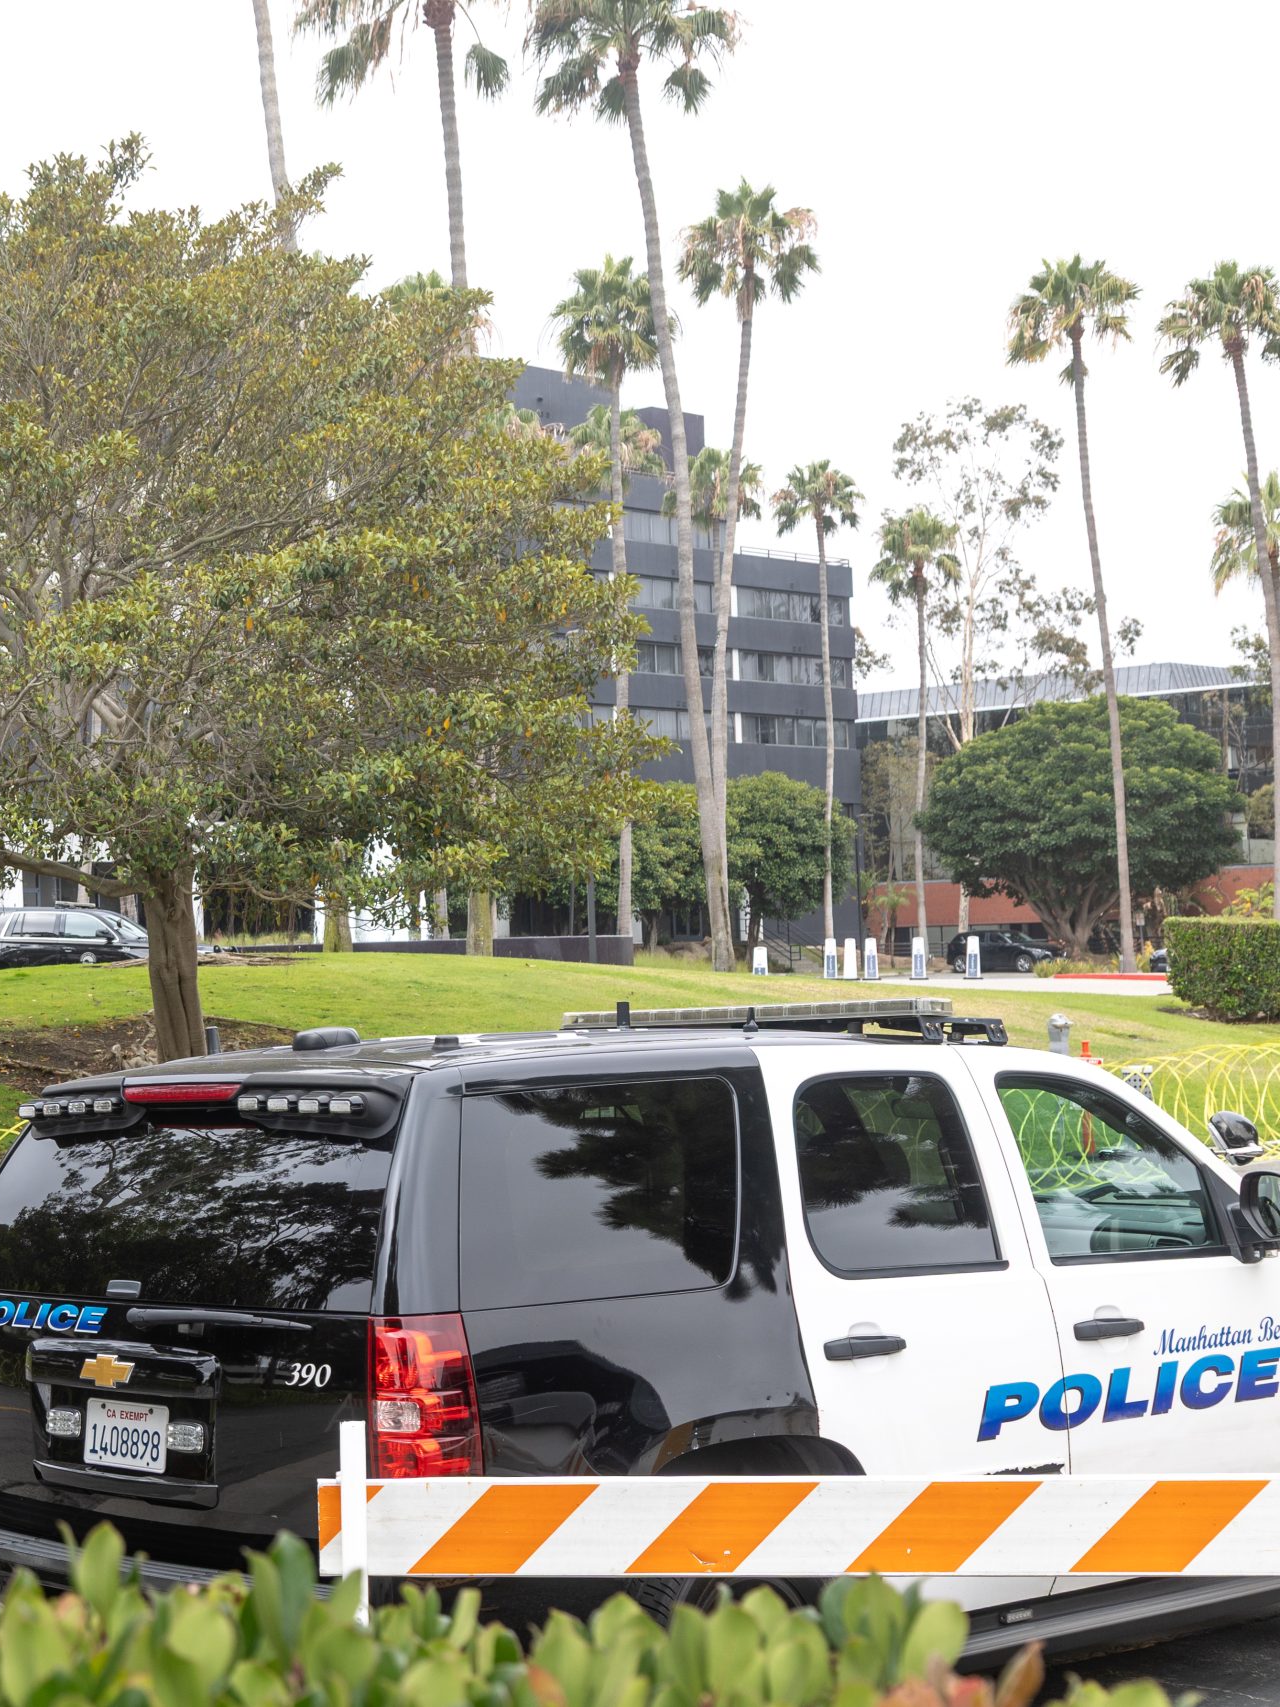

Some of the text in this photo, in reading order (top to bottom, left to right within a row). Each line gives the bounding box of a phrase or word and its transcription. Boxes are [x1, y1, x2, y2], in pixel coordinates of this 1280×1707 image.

[1153, 1324, 1253, 1356] Manhattan
[284, 1362, 332, 1388] 390
[976, 1347, 1280, 1442] POLICE
[106, 1408, 149, 1422] CA EXEMPT
[89, 1423, 161, 1462] 1408898
